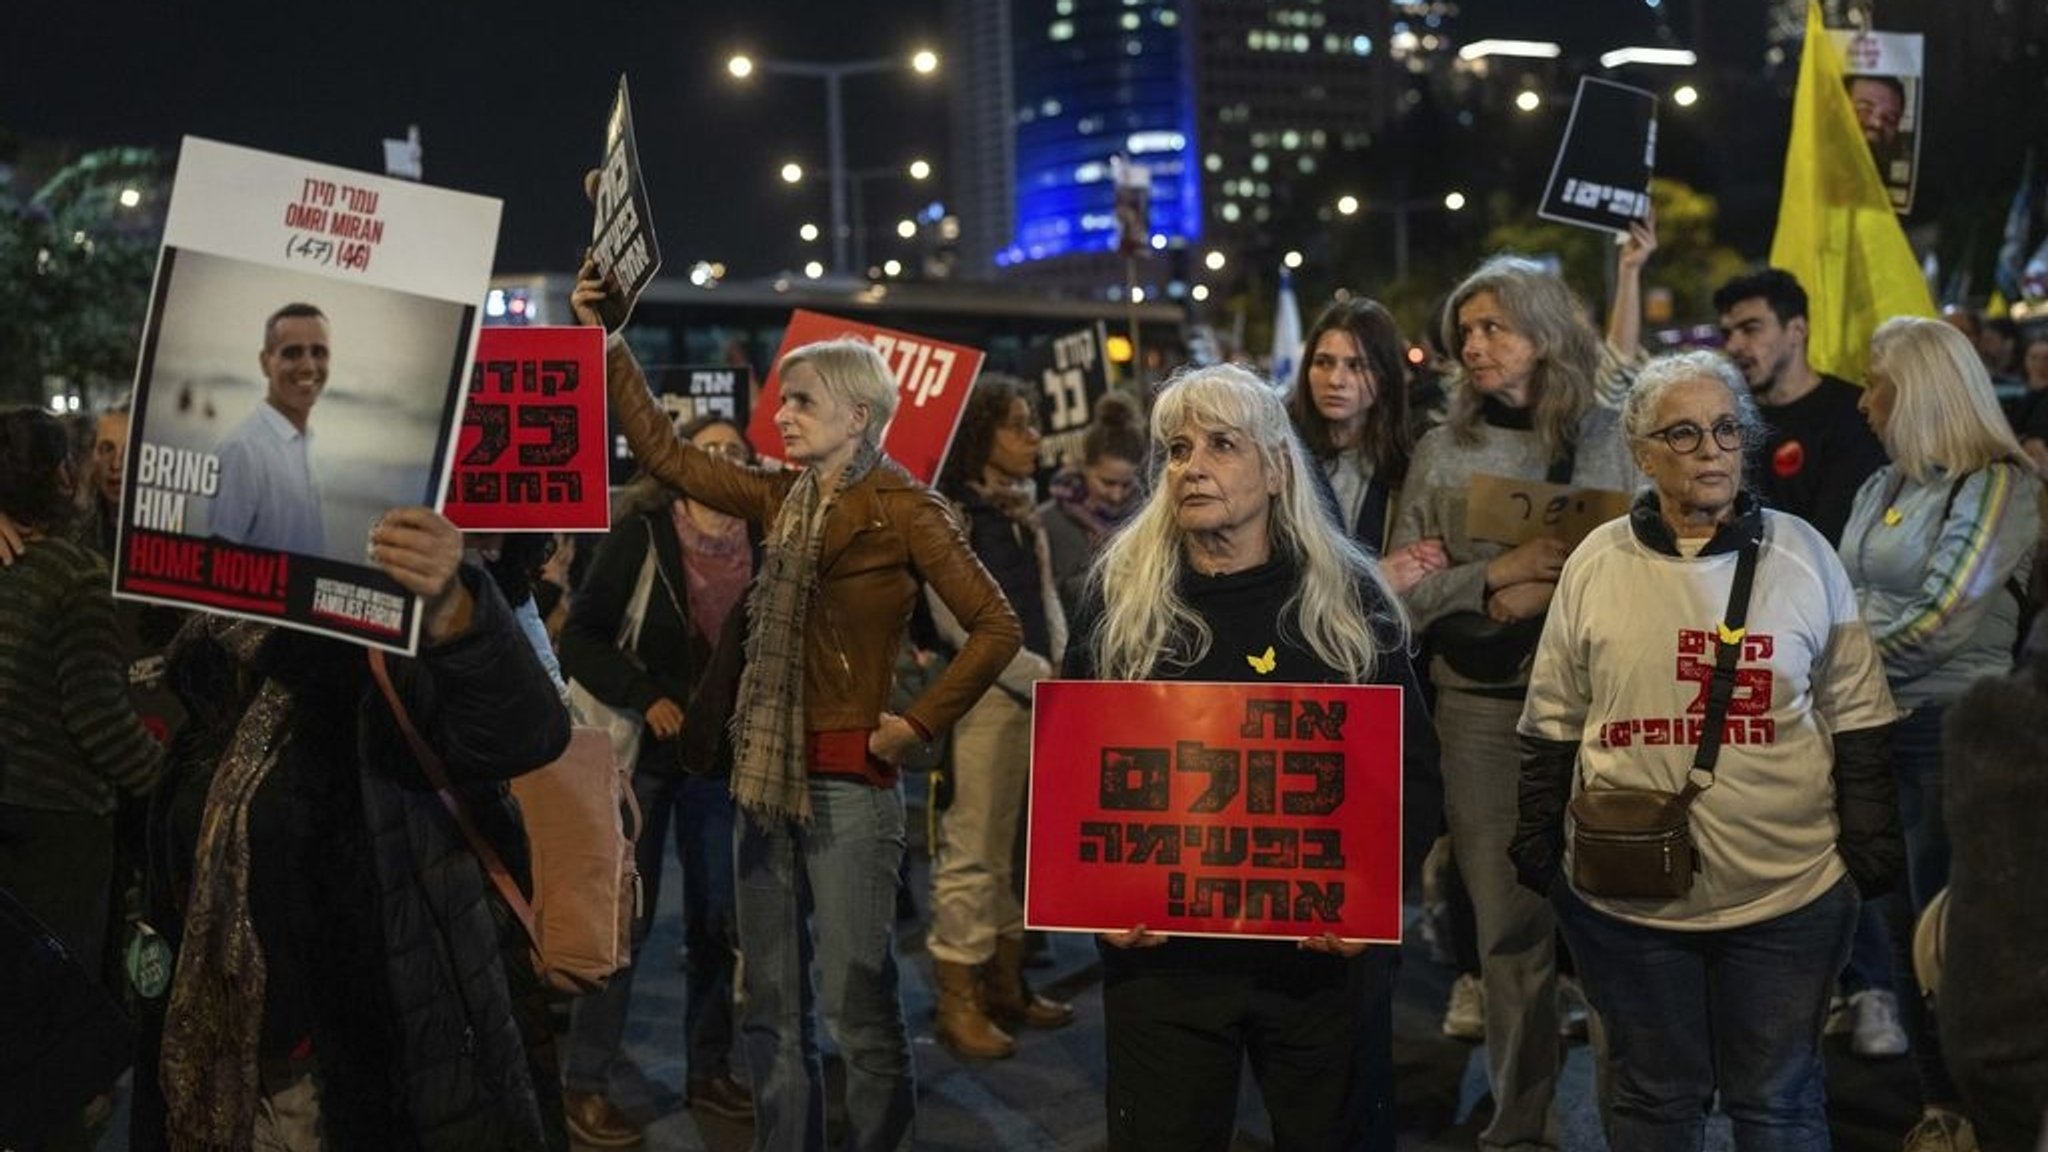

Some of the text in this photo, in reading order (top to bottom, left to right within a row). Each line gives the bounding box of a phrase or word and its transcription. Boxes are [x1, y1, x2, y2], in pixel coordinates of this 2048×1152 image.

[302, 178, 379, 214] עמרי מירן
[285, 202, 384, 245] OMRI MIRAN
[286, 234, 334, 265] (47)
[336, 240, 371, 272] (46)
[690, 371, 735, 395] את
[1043, 366, 1089, 430] כל
[660, 392, 735, 423] כול
[460, 396, 579, 467] כל
[137, 442, 221, 498] BRING
[133, 486, 186, 535] HIM
[128, 531, 288, 598] HOME NOW!
[313, 589, 403, 631] FAMILIES FORUM
[1678, 626, 1773, 661] קם
[1676, 655, 1773, 716] כל
[1240, 699, 1347, 741] את
[1099, 740, 1346, 816] כולם
[1079, 821, 1346, 870] בפעימה
[1167, 871, 1345, 923] אחת!
